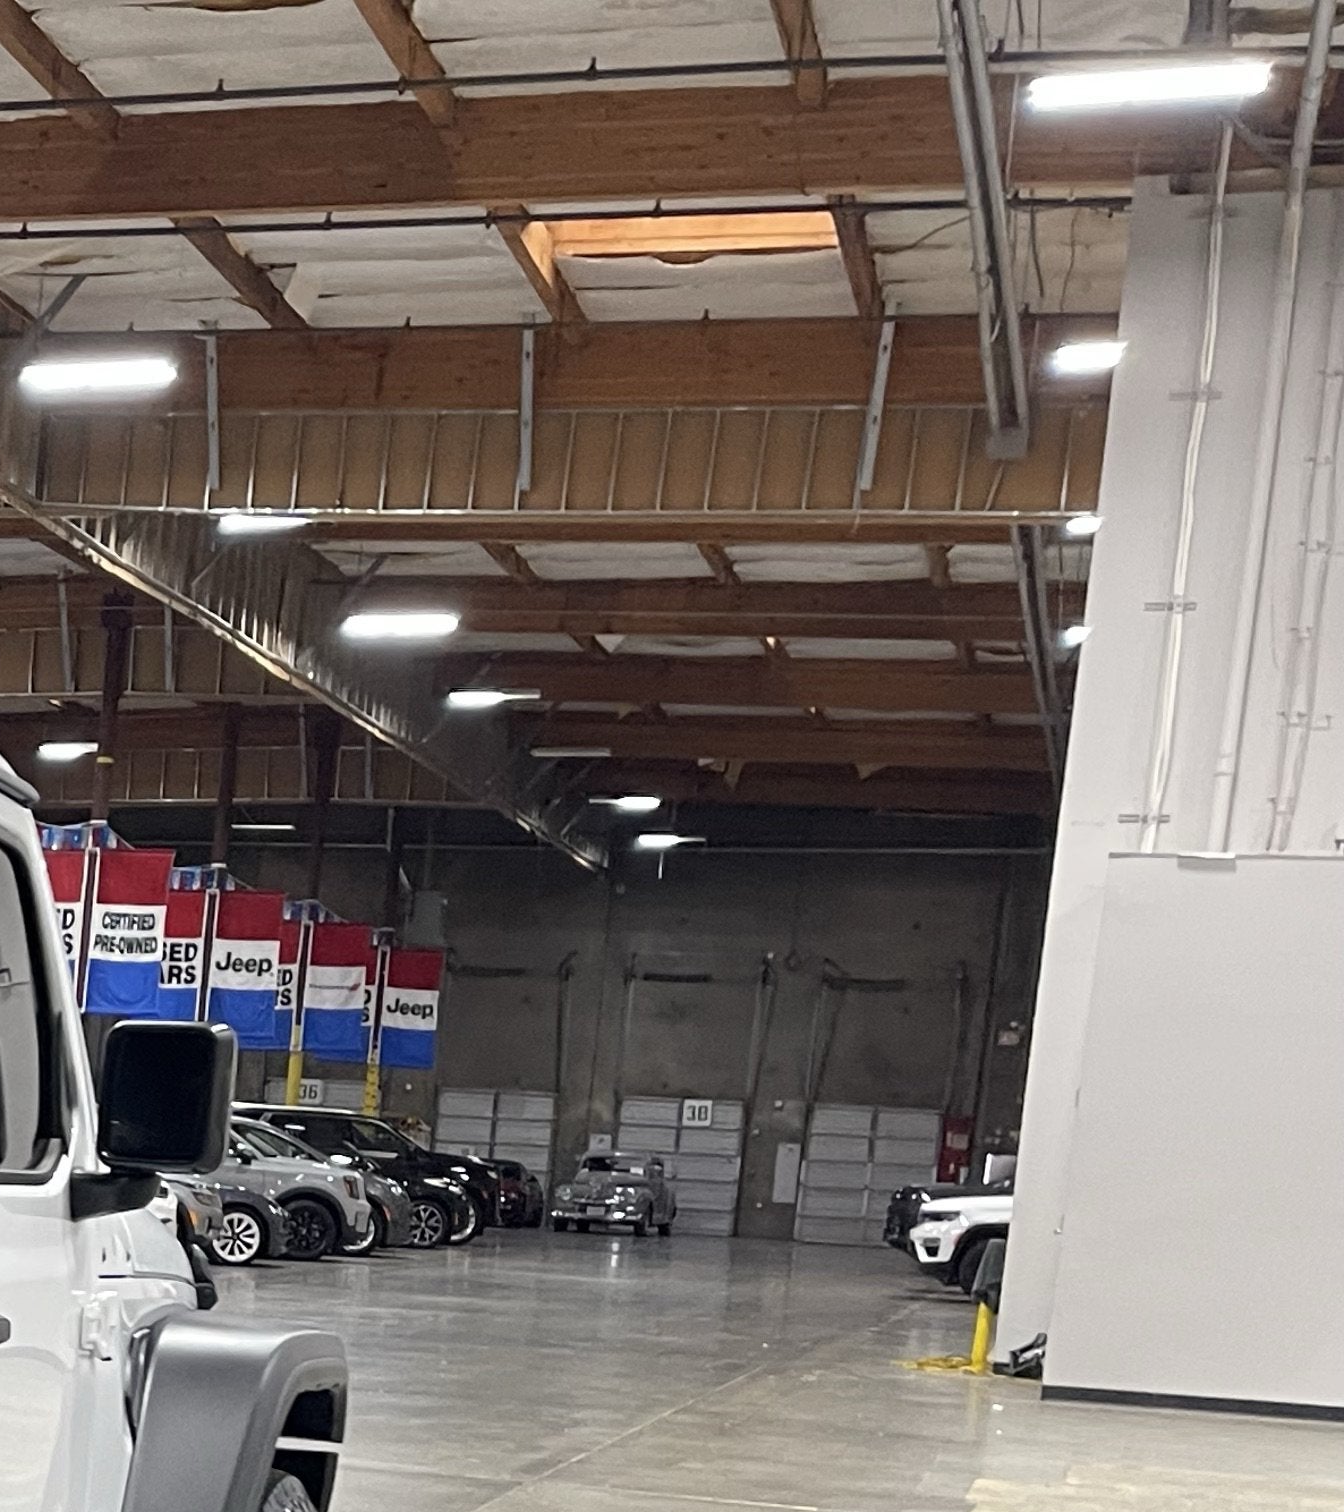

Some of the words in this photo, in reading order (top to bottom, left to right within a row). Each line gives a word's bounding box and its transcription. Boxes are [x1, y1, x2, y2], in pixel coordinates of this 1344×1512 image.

[102, 912, 156, 931] CERTIFIED
[94, 934, 158, 954] PRE-OWNED
[215, 951, 273, 977] Jeep
[386, 998, 434, 1019] Jeep
